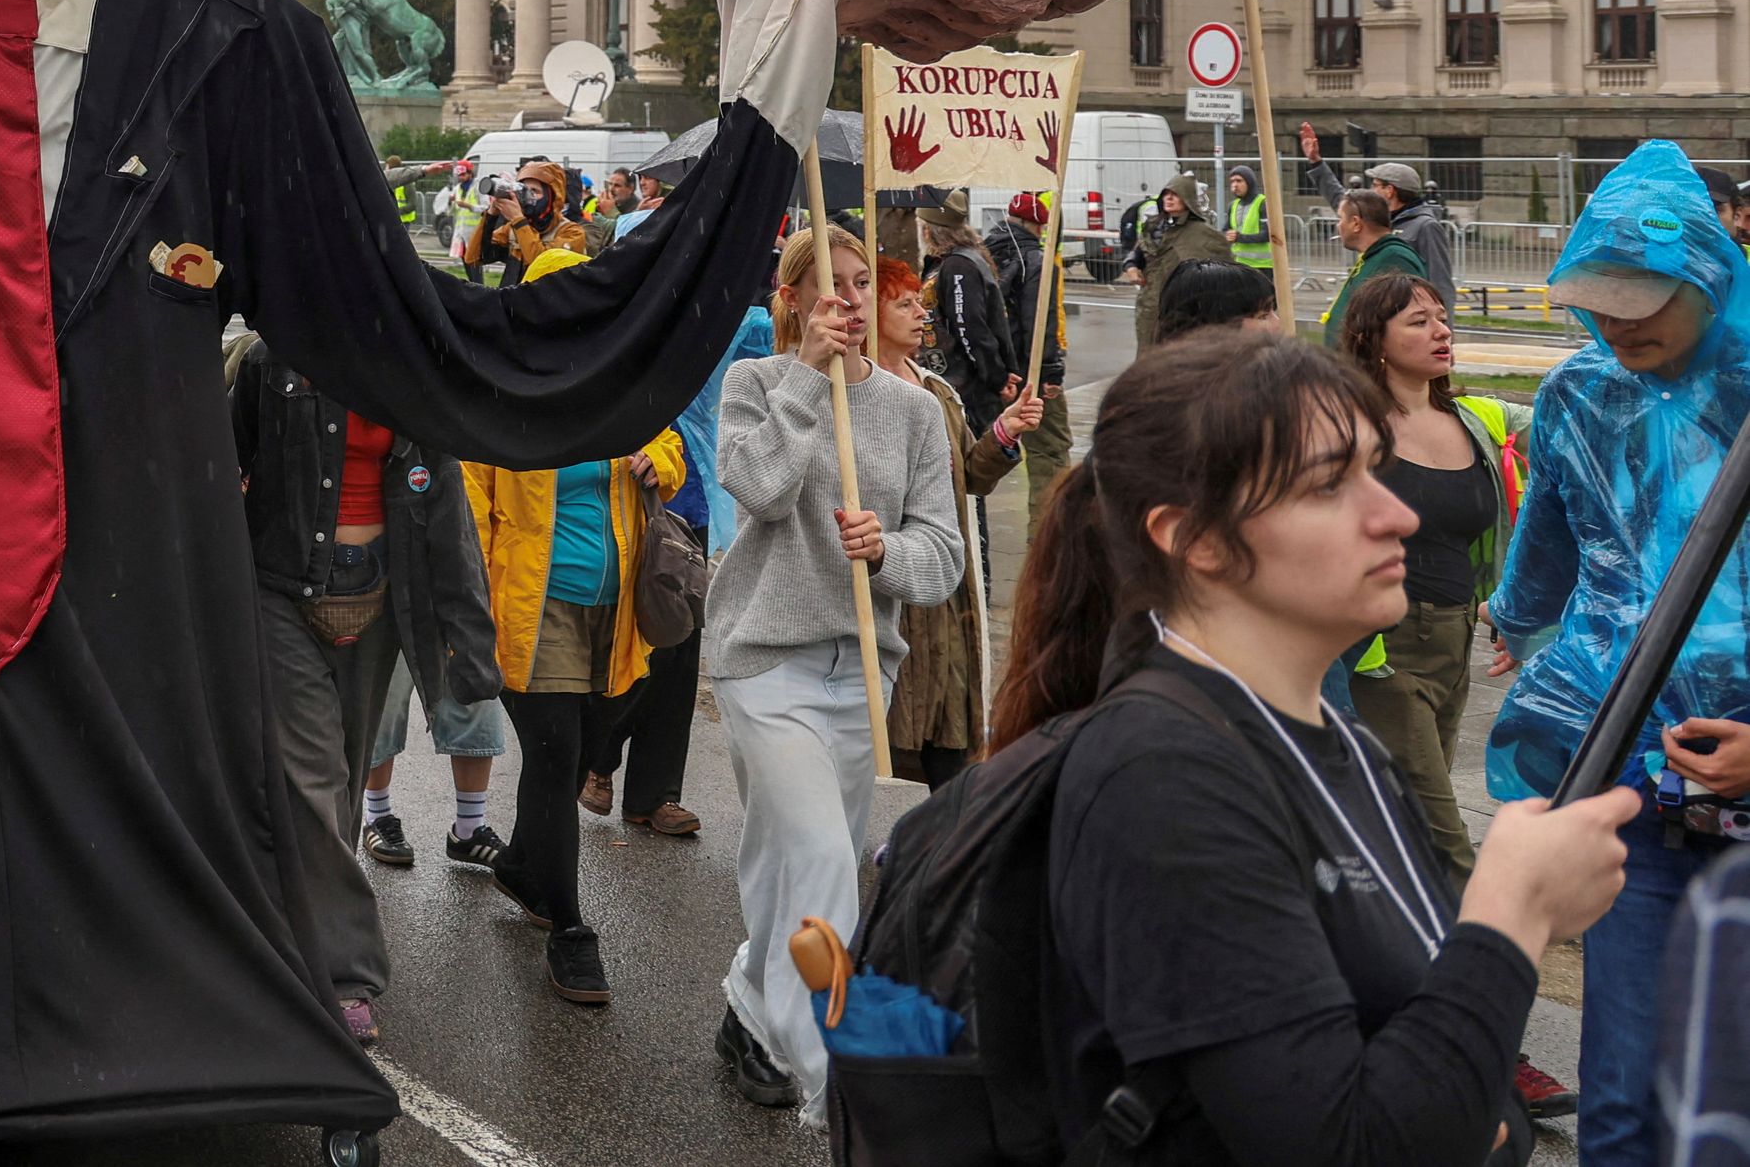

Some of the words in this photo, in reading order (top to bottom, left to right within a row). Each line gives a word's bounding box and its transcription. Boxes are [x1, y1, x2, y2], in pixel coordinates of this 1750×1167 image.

[892, 65, 1060, 99] KORUPCIJA
[944, 107, 1026, 141] UBIJA
[953, 274, 965, 324] РАВНА
